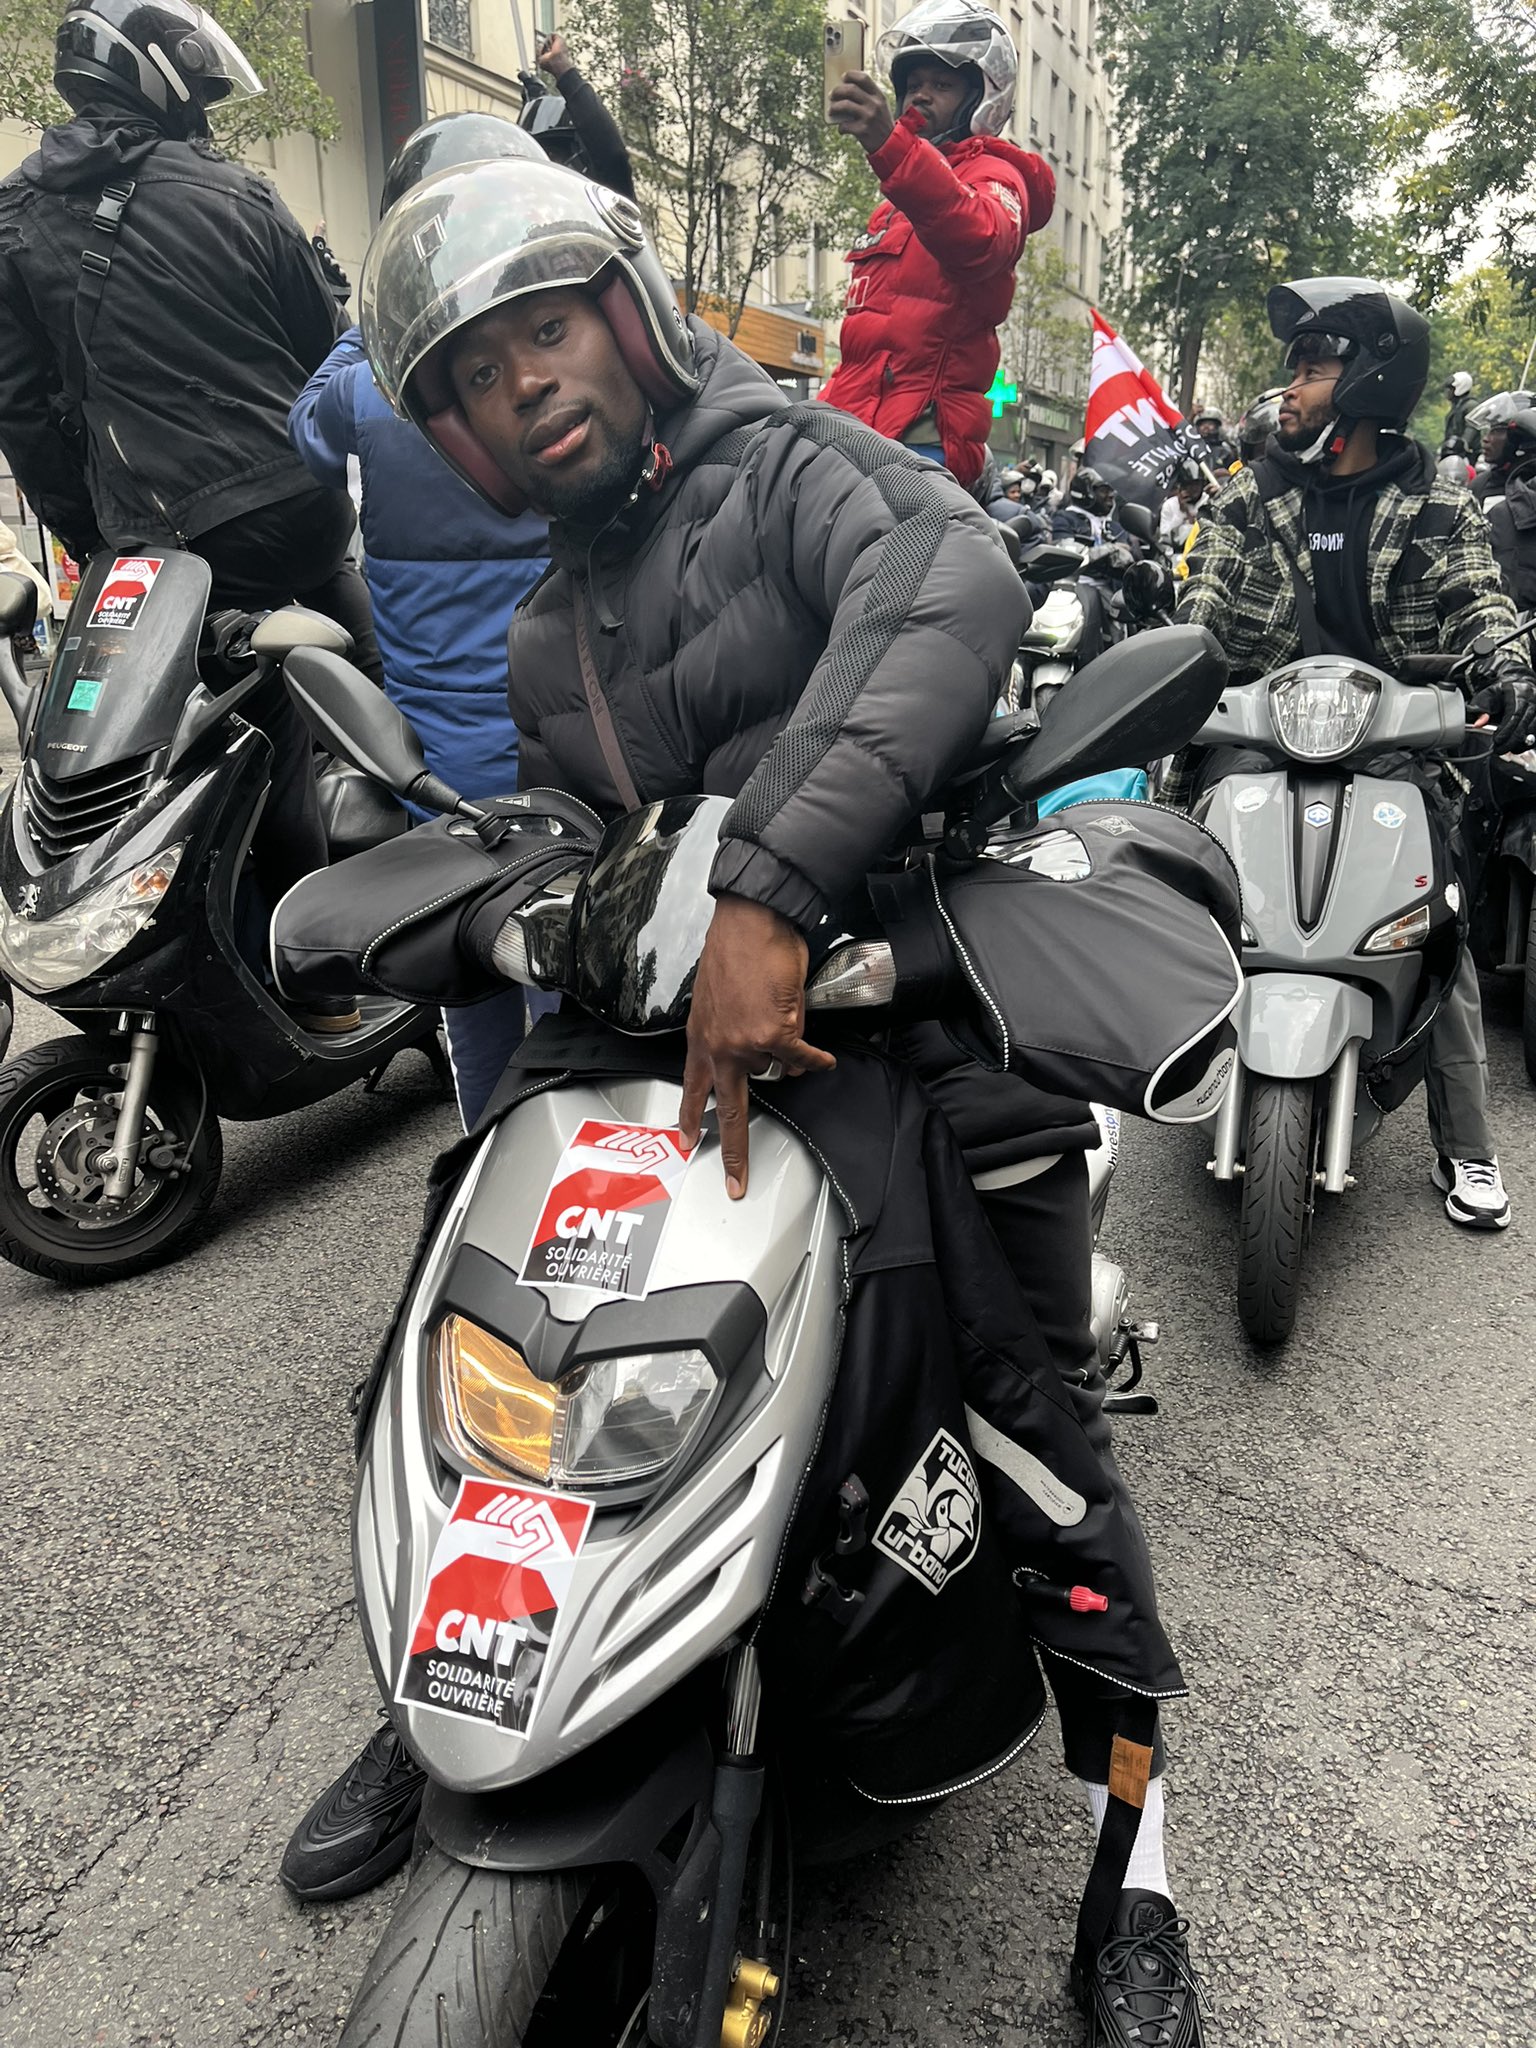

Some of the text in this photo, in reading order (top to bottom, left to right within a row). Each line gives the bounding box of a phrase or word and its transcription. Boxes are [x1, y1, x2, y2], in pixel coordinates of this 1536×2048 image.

[103, 596, 137, 610] CNT
[47, 743, 88, 752] PEUGEOT
[1414, 875, 1427, 888] S
[555, 1205, 645, 1246] CNT
[545, 1246, 633, 1270] SOLIDARITÉ
[546, 1263, 621, 1285] OUVRIÈRE
[435, 1609, 528, 1667] CNT
[426, 1659, 516, 1699] SOLIDARITÉ
[428, 1681, 505, 1718] OUVRIÈRE
